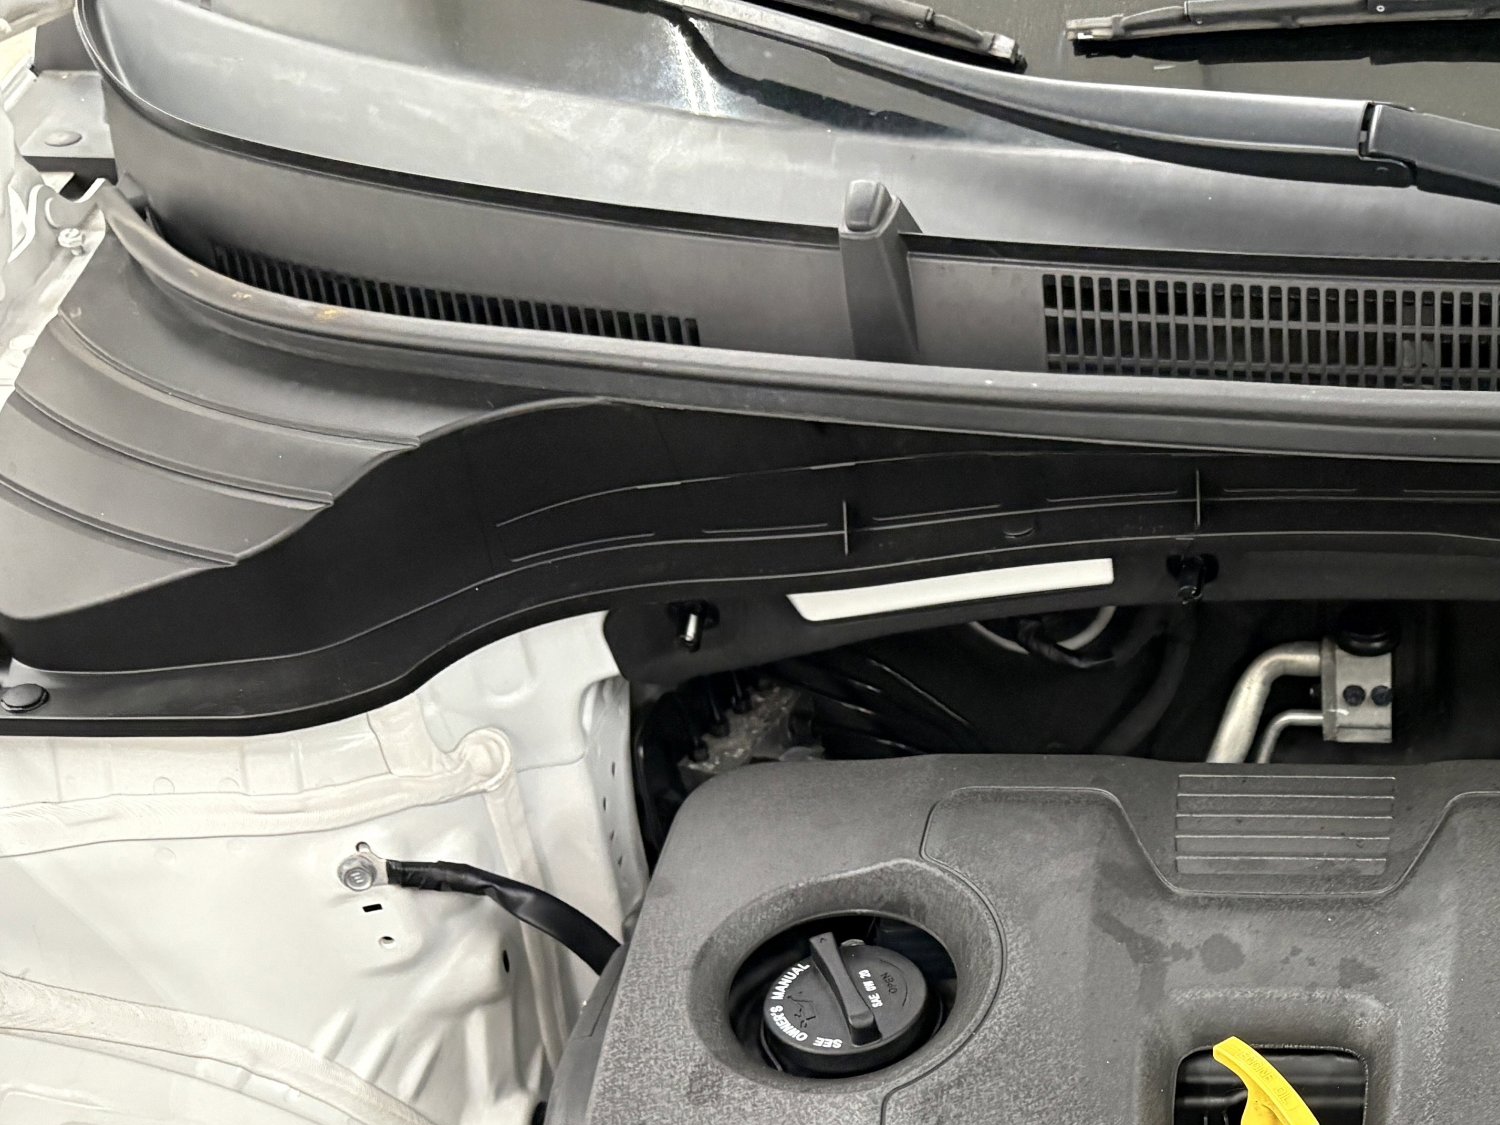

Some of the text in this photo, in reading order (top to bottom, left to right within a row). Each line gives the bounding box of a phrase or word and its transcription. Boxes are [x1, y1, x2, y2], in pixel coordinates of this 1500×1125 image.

[880, 972, 898, 995] OPEN
[770, 963, 843, 1049] SEE OWNER'S MANUAL
[868, 993, 883, 1008] SAE
